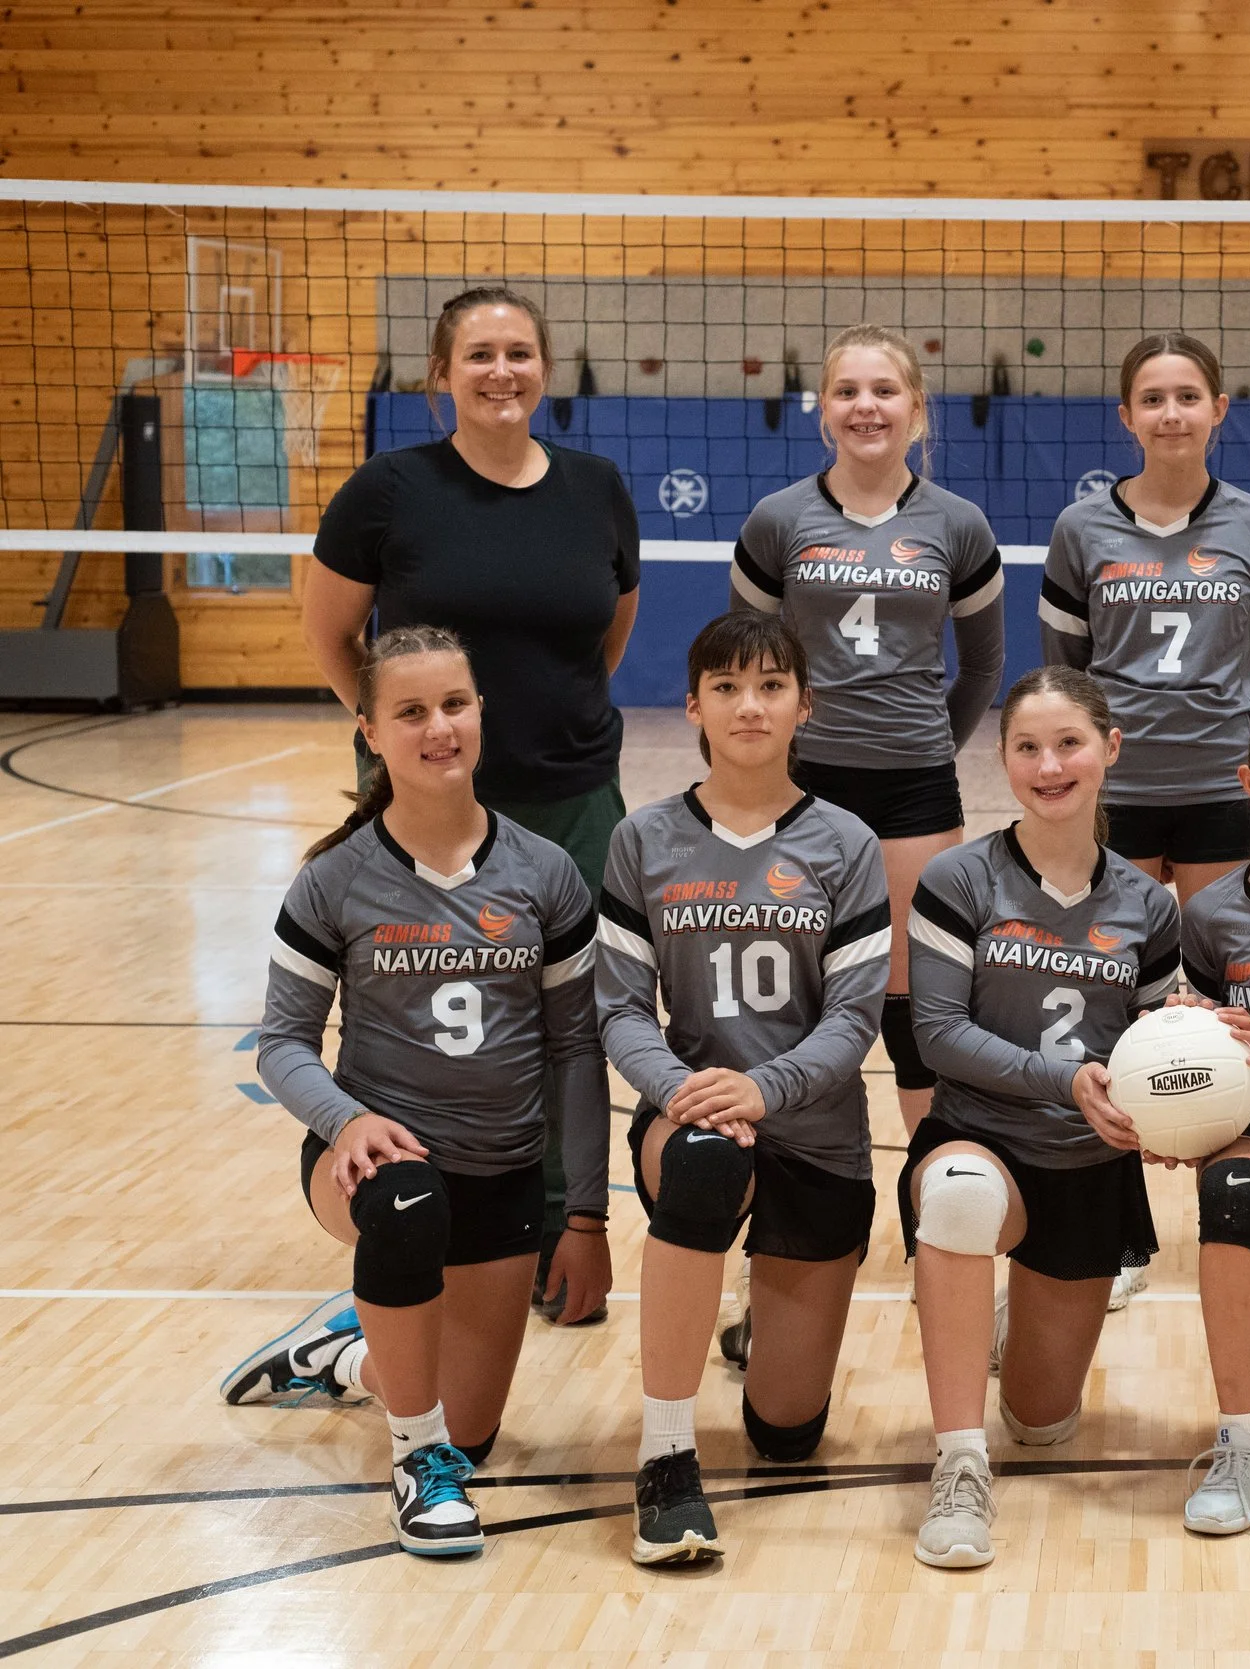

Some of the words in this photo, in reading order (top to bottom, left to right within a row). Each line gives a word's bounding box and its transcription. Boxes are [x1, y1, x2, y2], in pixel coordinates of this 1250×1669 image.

[796, 562, 941, 595] NAVIGATORS
[1102, 580, 1241, 608] NAVIGATORS
[838, 594, 880, 656] 4
[1150, 611, 1192, 674] 7
[662, 881, 739, 904] COMPASS
[373, 923, 453, 943] COMPASS
[662, 904, 827, 936] NAVIGATORS
[373, 945, 540, 976] NAVIGATORS
[984, 940, 1139, 991] NAVIGATORS
[709, 940, 791, 1018] 10
[431, 981, 485, 1057] 9
[1040, 987, 1086, 1061] 2
[1147, 1070, 1212, 1091] TACHIKARA
